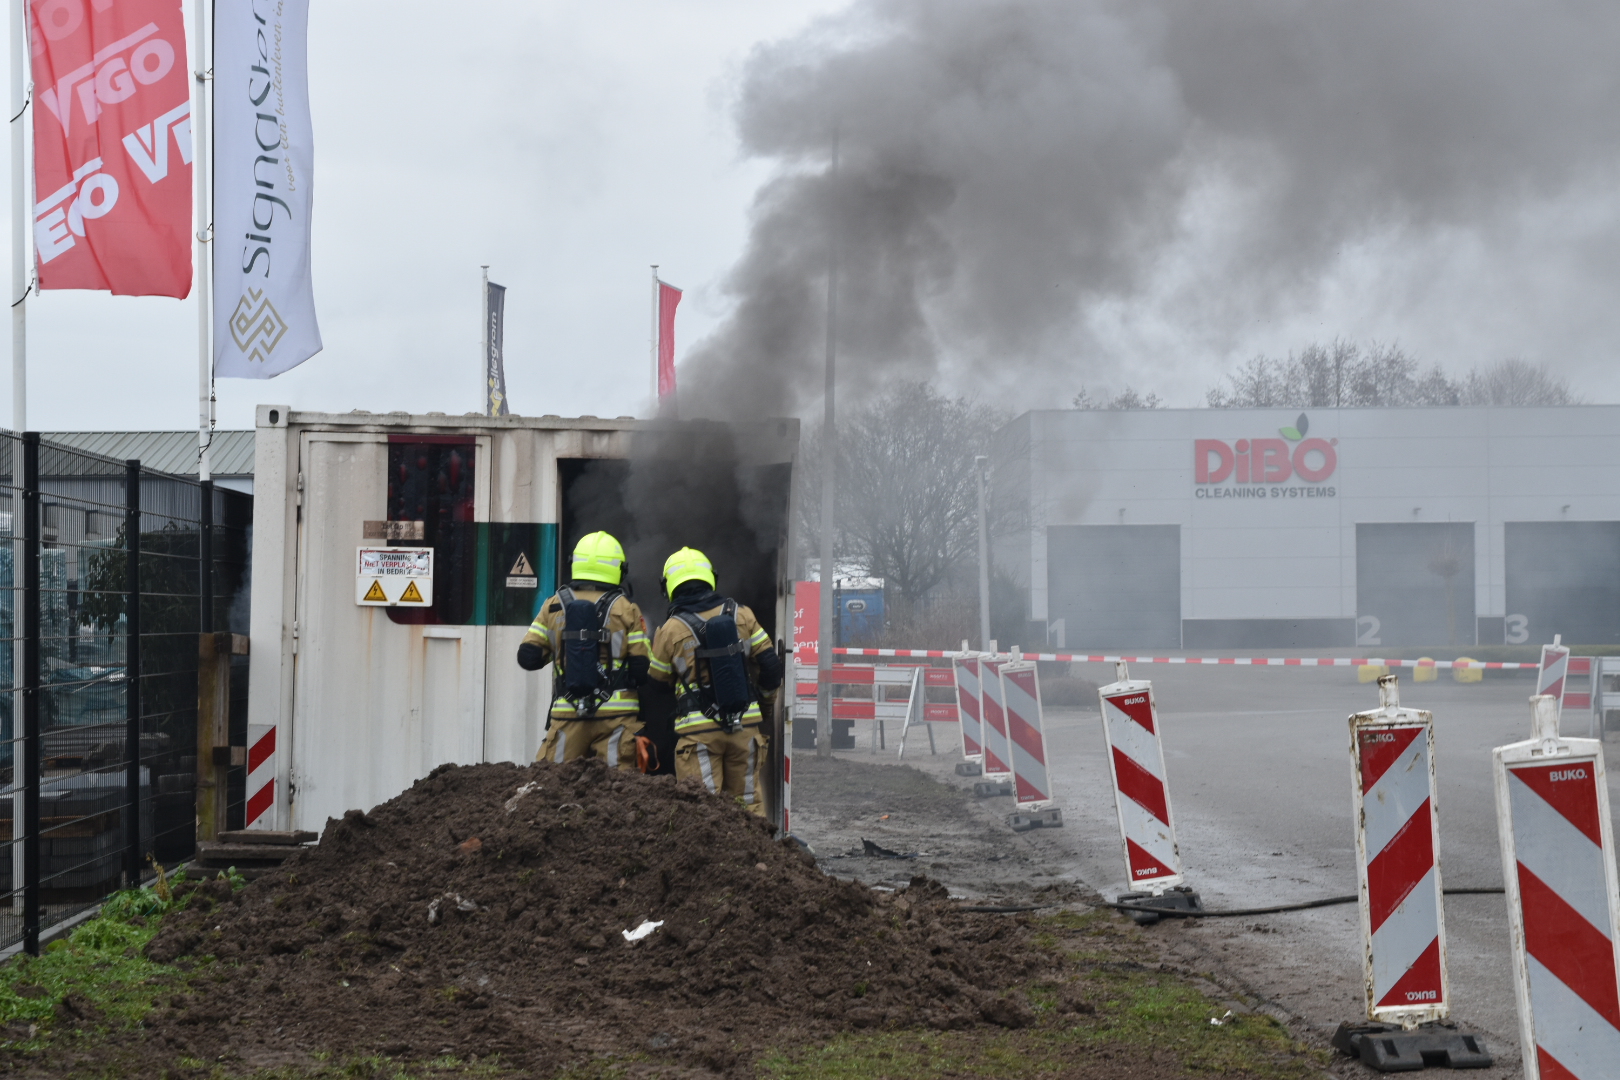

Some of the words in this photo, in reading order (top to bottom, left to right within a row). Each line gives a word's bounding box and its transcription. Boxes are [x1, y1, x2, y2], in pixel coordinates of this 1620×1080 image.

[271, 21, 285, 116] buitenleven
[278, 121, 290, 151] een
[287, 153, 297, 192] voor
[1195, 487, 1267, 498] CLEANING
[1270, 486, 1337, 498] SYSTEMS
[379, 553, 412, 561] SPANNING
[1048, 618, 1066, 649] 1
[1357, 615, 1382, 646] 2
[1505, 613, 1530, 645] 3
[1549, 768, 1589, 782] BUKO.
